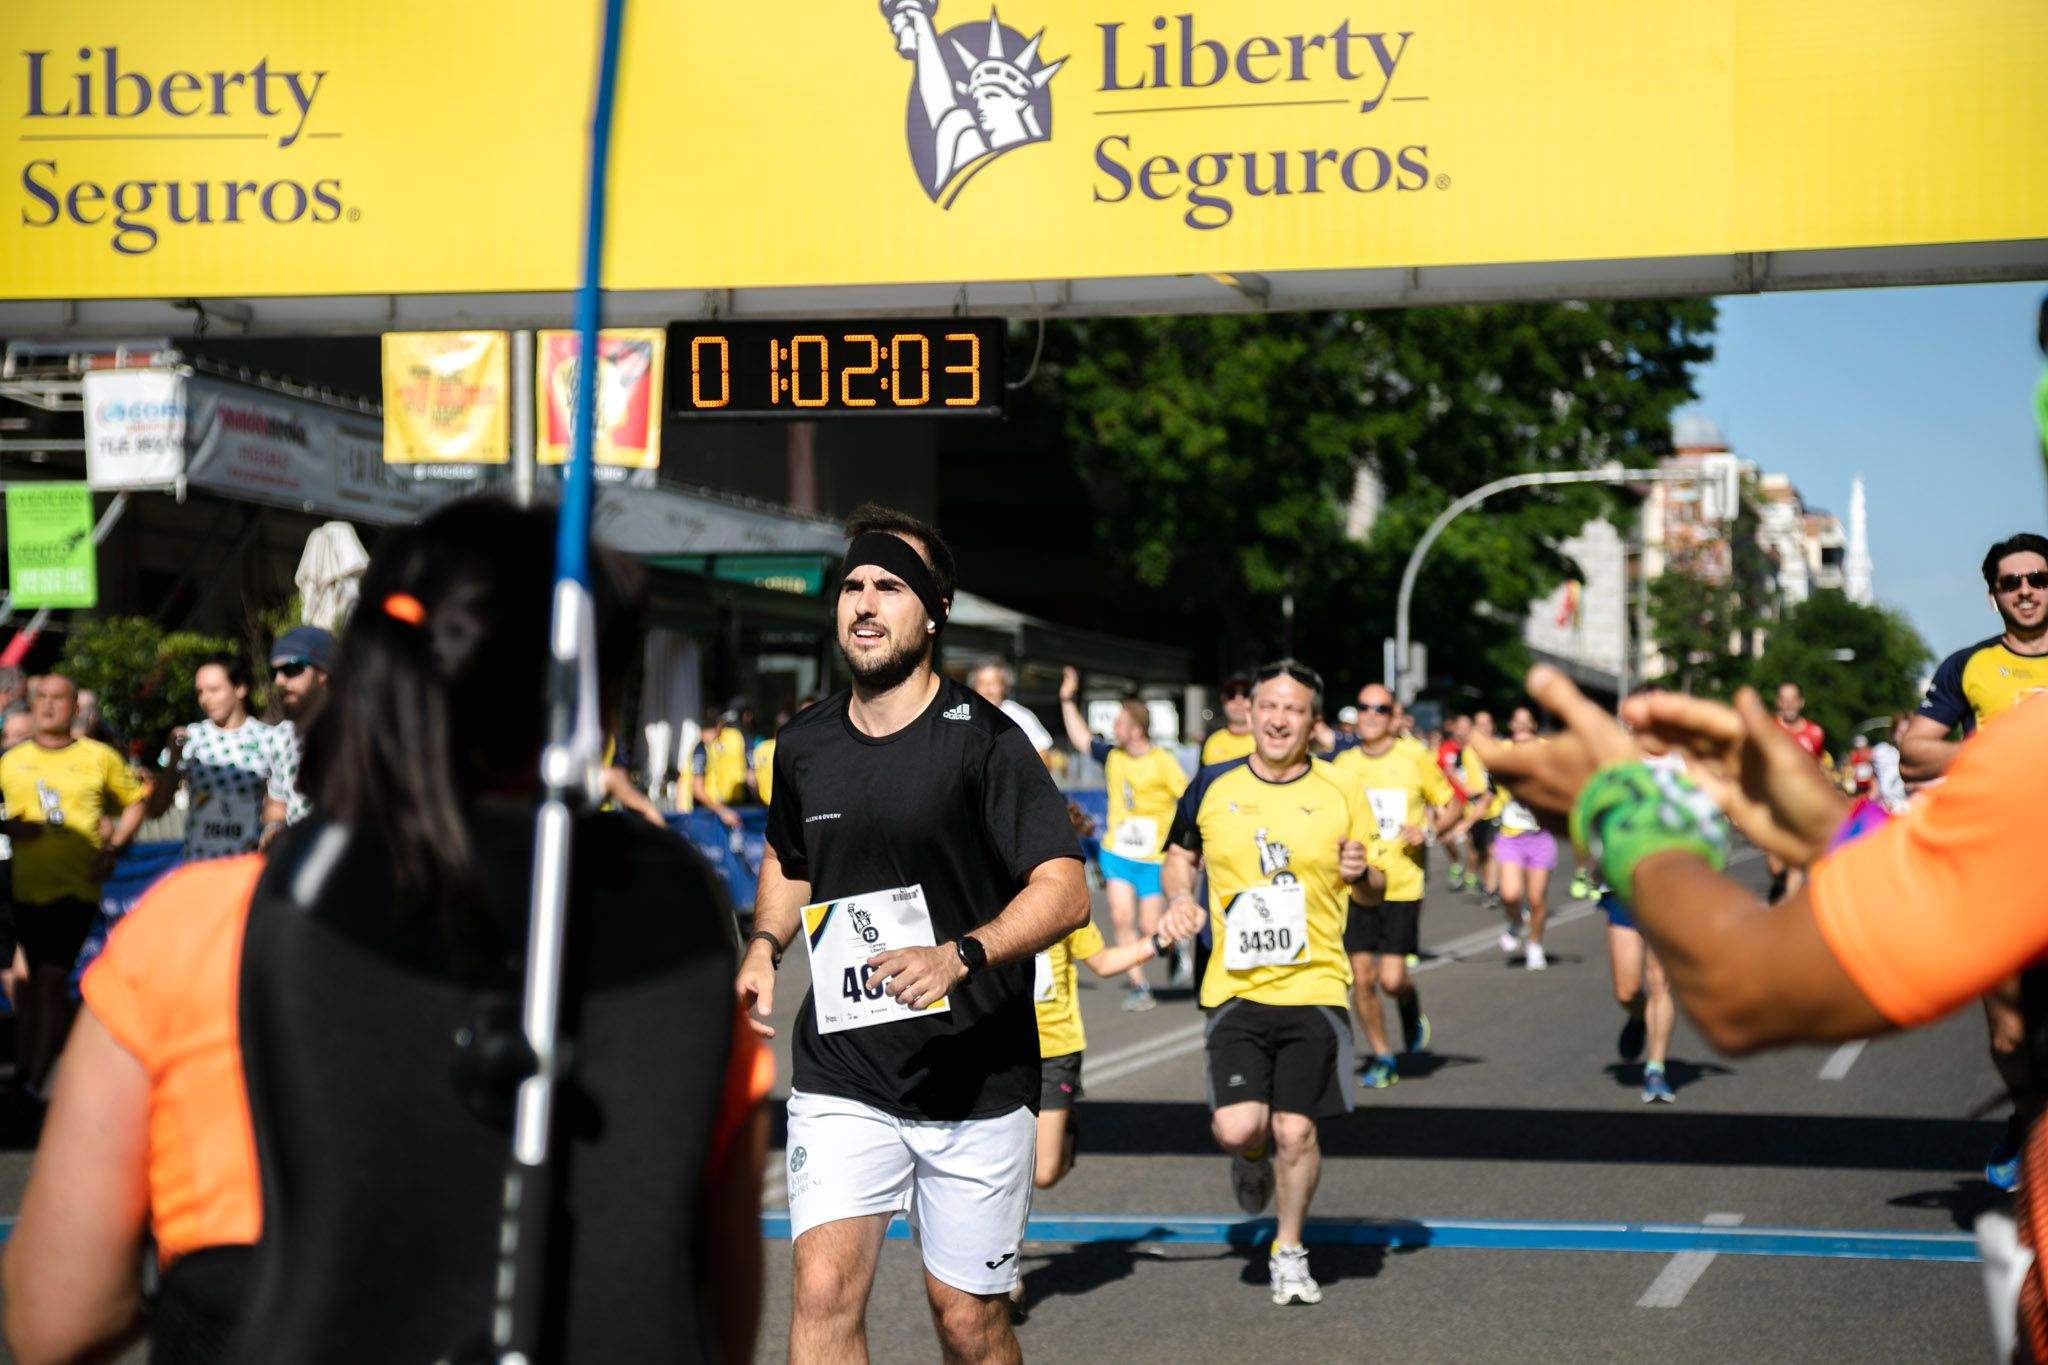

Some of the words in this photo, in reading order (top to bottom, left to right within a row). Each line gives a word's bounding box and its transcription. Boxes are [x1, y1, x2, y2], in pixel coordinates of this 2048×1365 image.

[1094, 13, 1414, 114] Liberty
[20, 45, 328, 148] Liberty
[943, 711, 972, 721] adidas
[864, 929, 877, 941] 13
[1240, 928, 1291, 954] 3430
